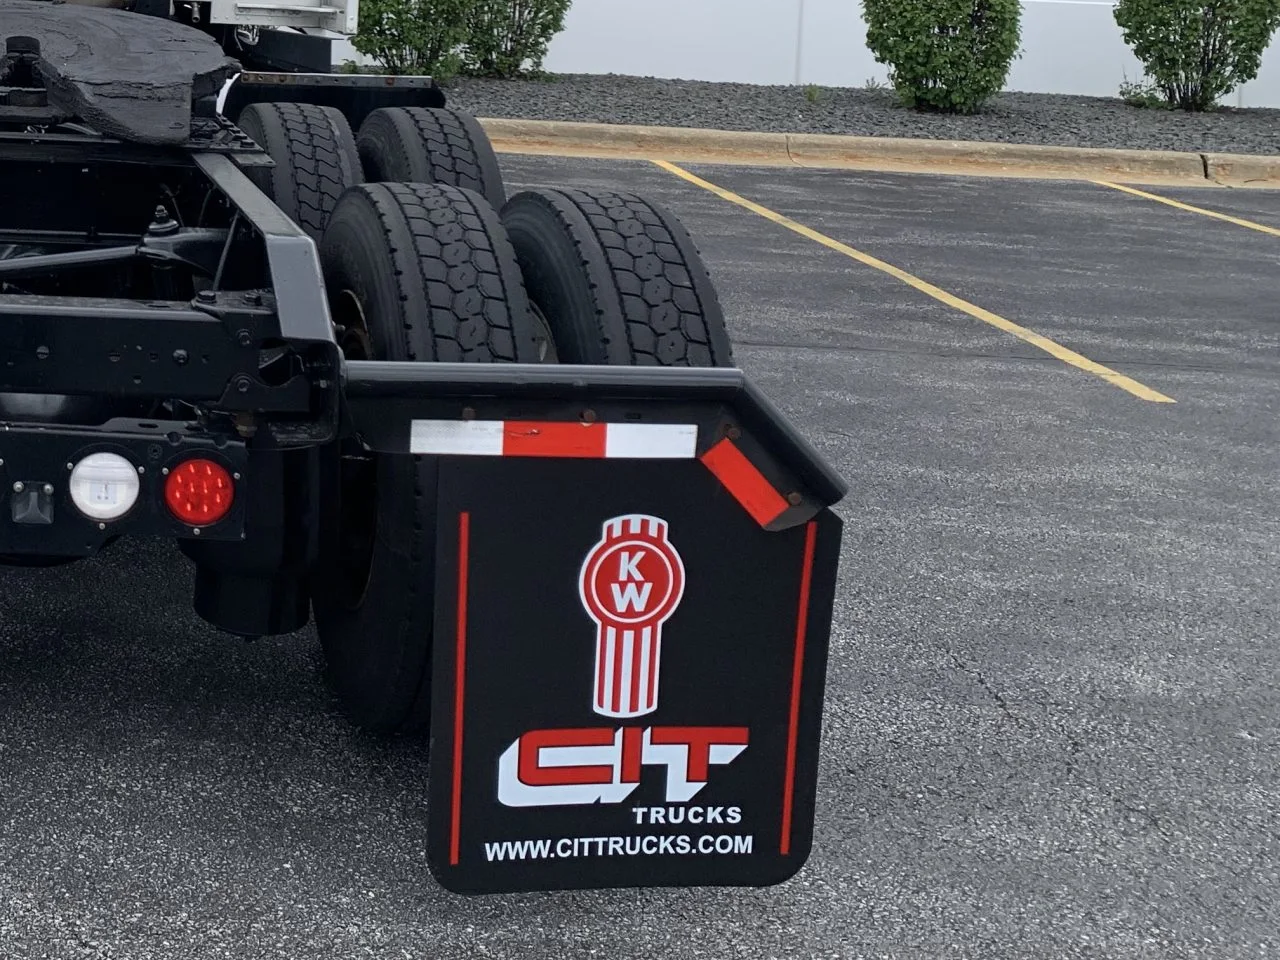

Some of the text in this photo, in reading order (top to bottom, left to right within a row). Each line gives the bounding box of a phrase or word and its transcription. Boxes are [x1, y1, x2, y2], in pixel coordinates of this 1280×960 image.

[619, 551, 645, 581] K
[610, 582, 652, 612] W
[498, 726, 749, 807] CIT
[632, 806, 742, 825] TRUCKS
[485, 835, 753, 861] WWW.CITTRUCKS.COM
